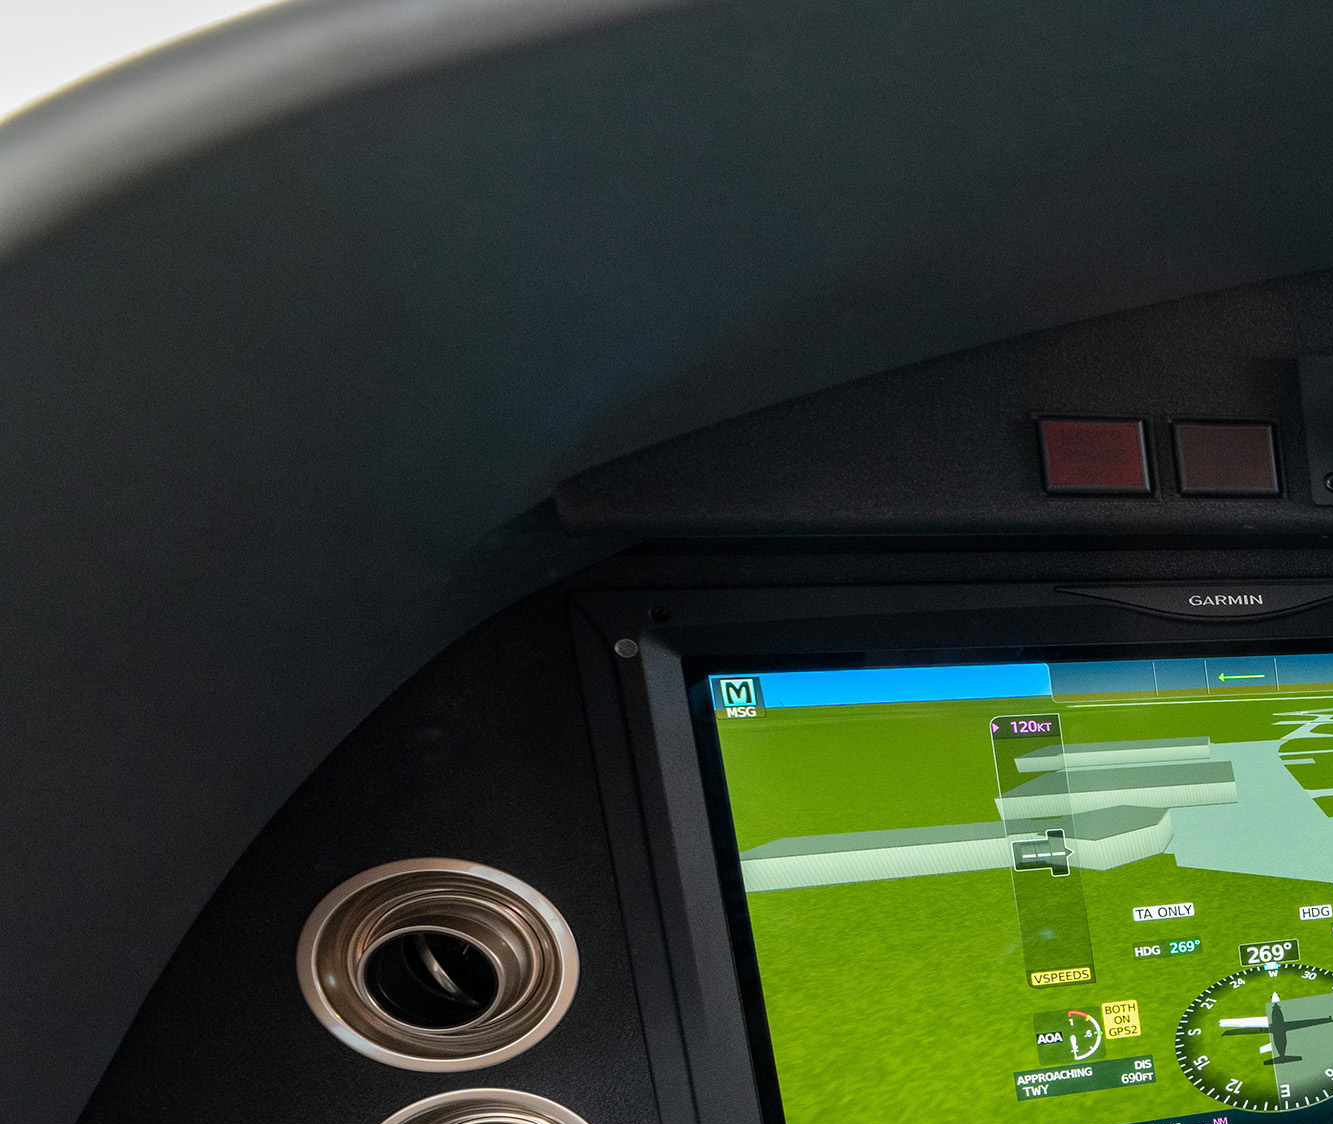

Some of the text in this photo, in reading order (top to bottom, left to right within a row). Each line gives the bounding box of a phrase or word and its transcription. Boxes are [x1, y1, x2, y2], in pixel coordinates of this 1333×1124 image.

[1189, 595, 1263, 606] GARMIN
[726, 706, 756, 718] MSG
[1010, 719, 1052, 734] 120KT
[1135, 905, 1192, 919] TA ONLY
[1135, 939, 1200, 957] HDG 269°
[1246, 943, 1292, 962] 269°
[1033, 969, 1089, 984] VSPEEDS
[1104, 1003, 1136, 1016] BOTH
[1114, 1014, 1130, 1025] ON
[1108, 1025, 1138, 1037] GPS2
[1037, 1032, 1063, 1044] AOA
[1017, 1068, 1093, 1085] APPROACHING
[1022, 1084, 1049, 1097] TWY
